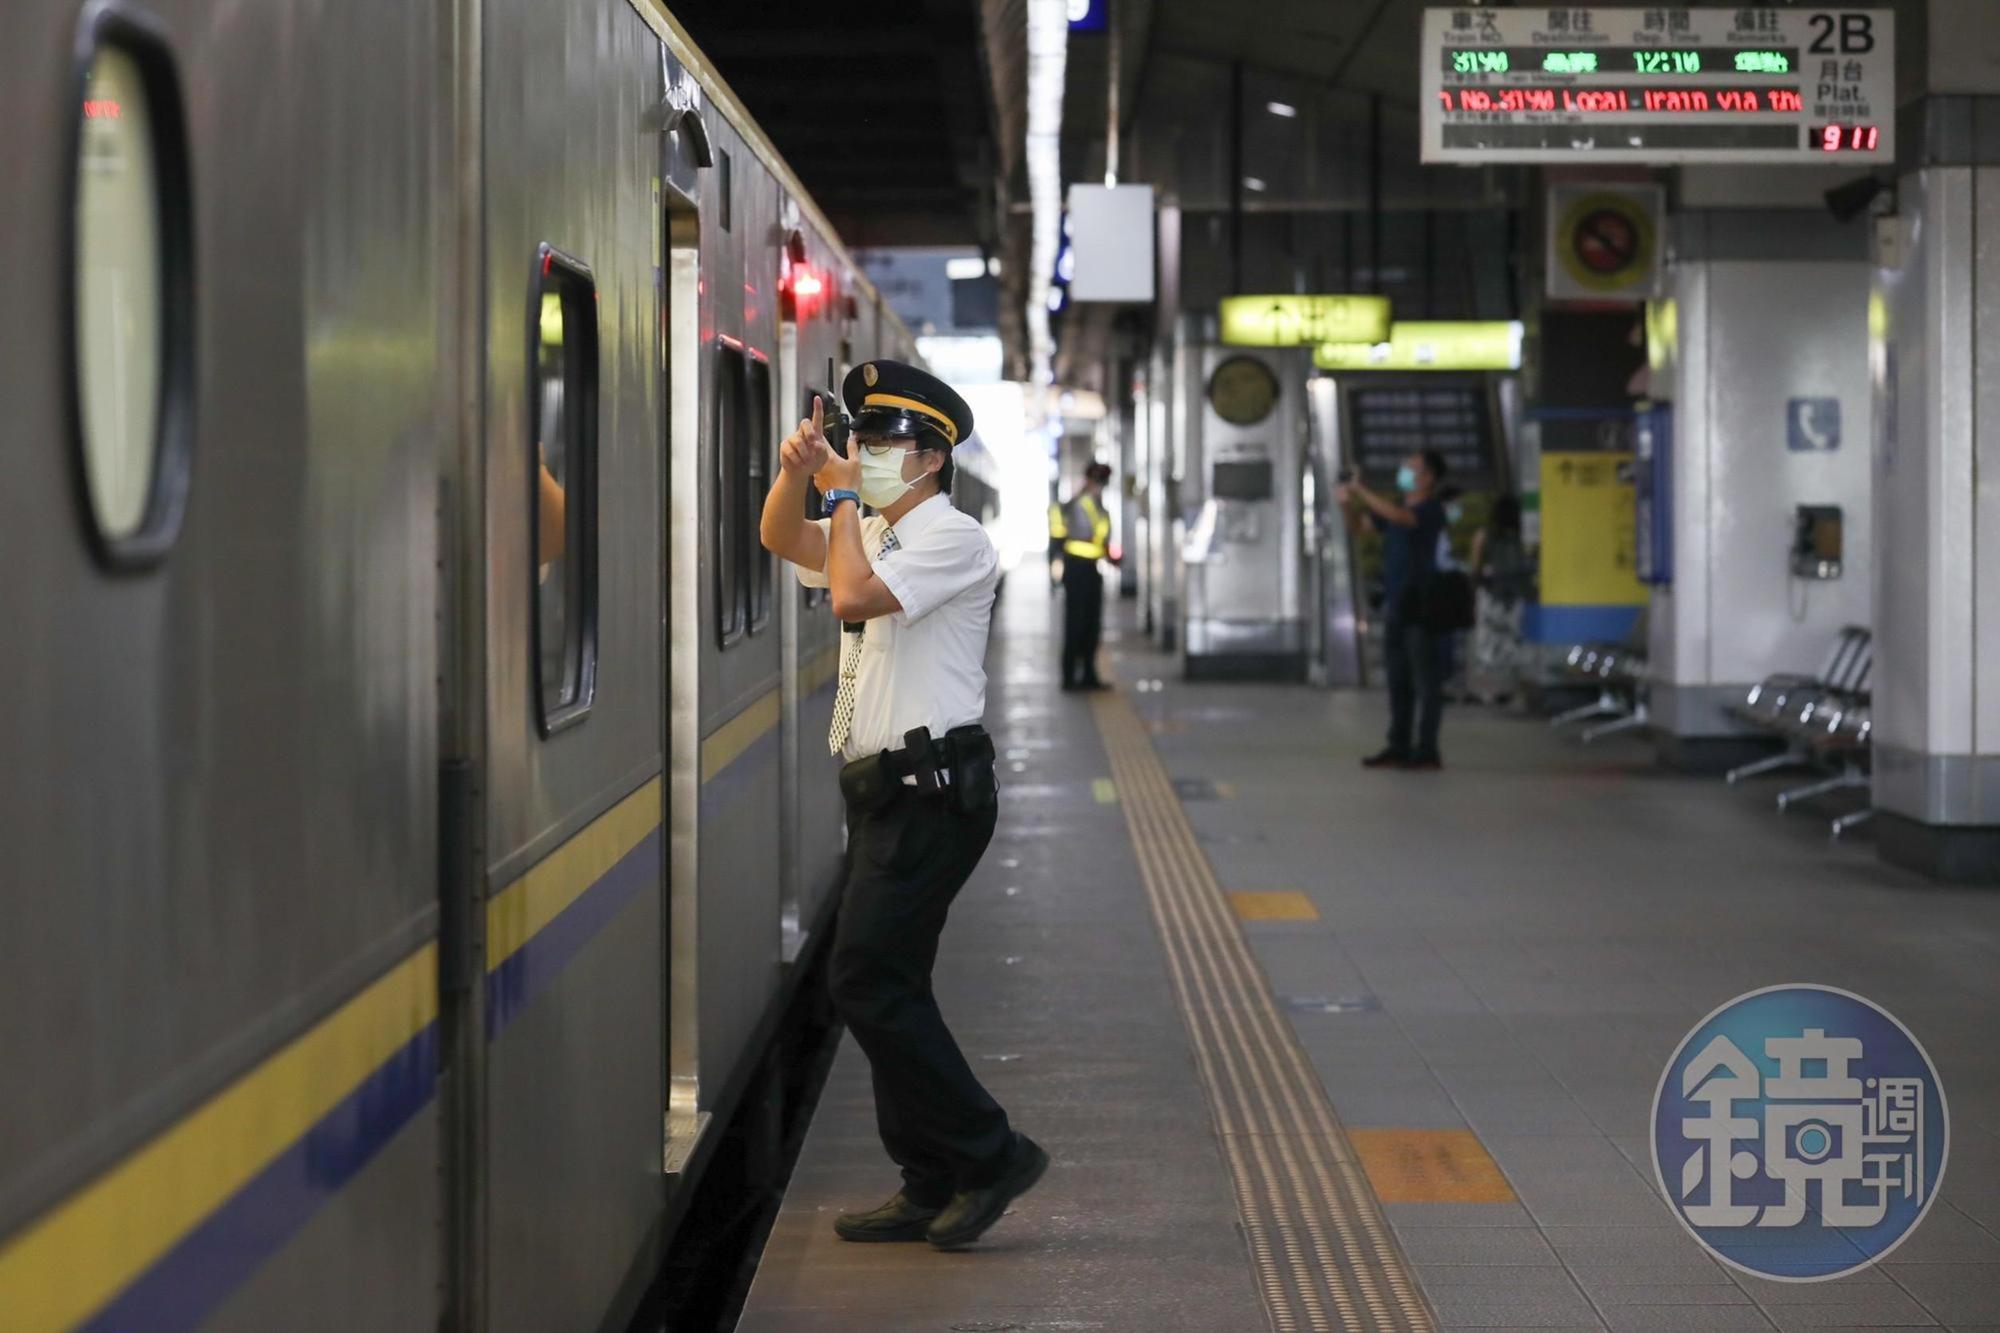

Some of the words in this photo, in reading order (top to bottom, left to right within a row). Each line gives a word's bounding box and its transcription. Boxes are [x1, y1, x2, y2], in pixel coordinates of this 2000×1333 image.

[1808, 13, 1875, 55] 2B
[1633, 51, 1700, 73] 12:10
[1820, 60, 1863, 82] 月台
[1716, 91, 1758, 111] via
[1818, 84, 1865, 102] Plat.
